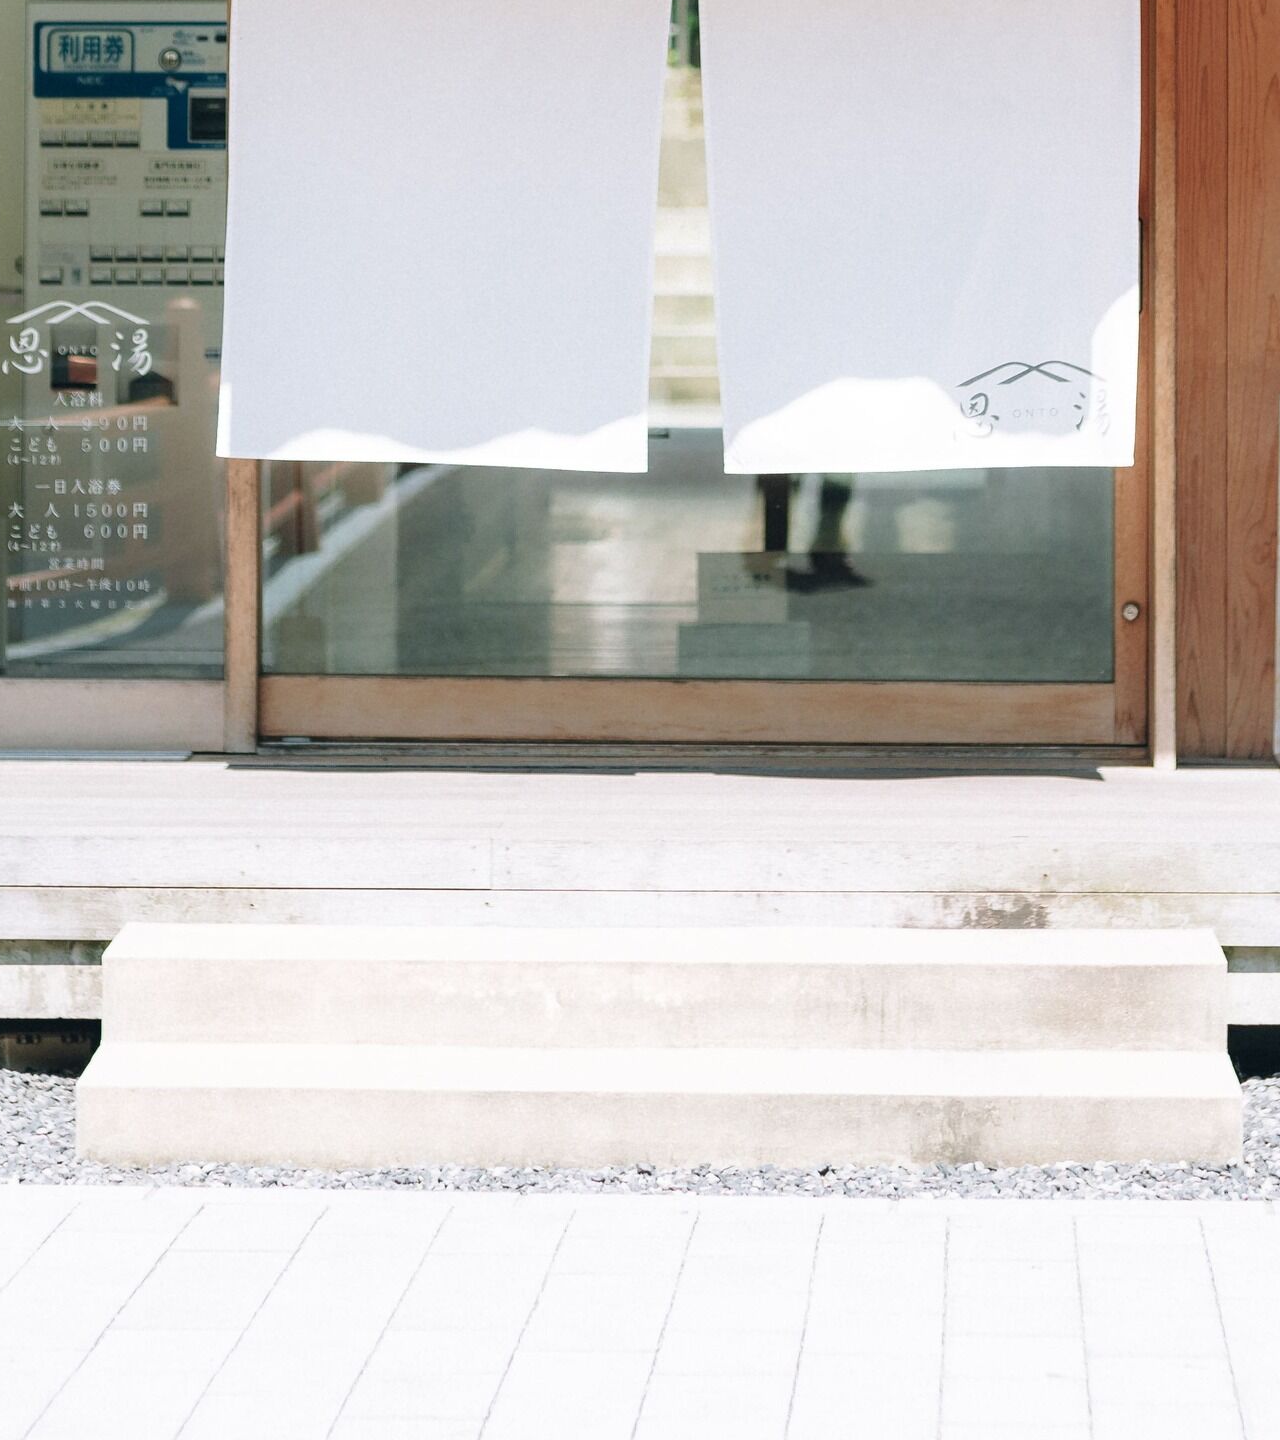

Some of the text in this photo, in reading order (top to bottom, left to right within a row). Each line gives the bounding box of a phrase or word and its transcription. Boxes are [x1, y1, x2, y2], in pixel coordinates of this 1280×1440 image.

[58, 35, 124, 63] 利用券
[57, 344, 98, 356] ONTO
[53, 391, 105, 407] 入浴料
[1012, 407, 1058, 418] ONTO
[9, 436, 148, 453] こども 500円
[34, 478, 123, 495] 一日入浴券
[73, 501, 148, 519] 1500円
[9, 523, 148, 540] こども 600円
